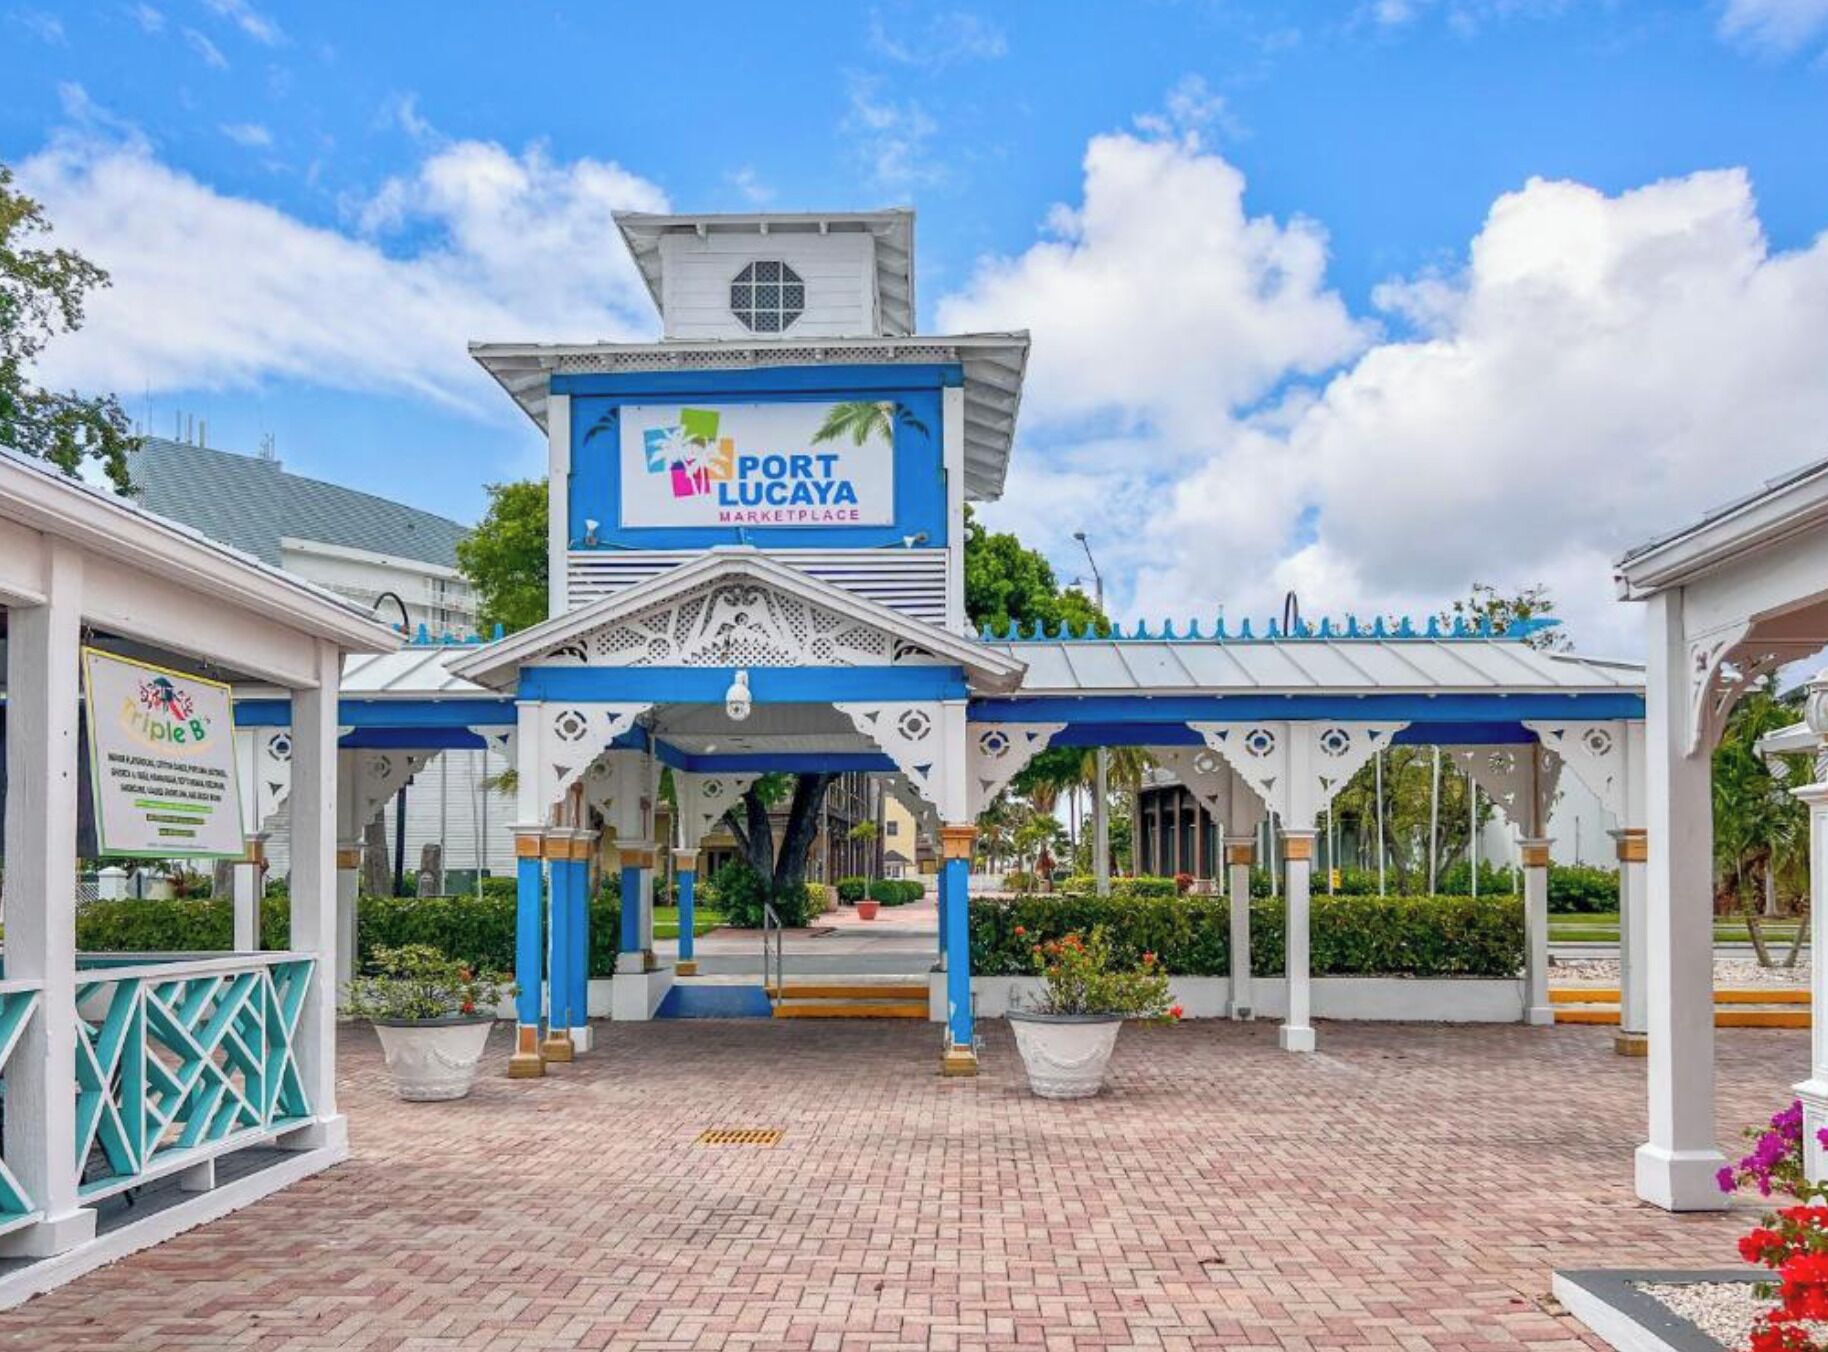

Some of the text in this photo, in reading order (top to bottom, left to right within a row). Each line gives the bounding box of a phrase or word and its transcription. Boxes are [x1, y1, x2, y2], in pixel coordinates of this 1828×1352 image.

[738, 454, 839, 479] PORT
[718, 480, 858, 506] LUCAYA
[719, 509, 860, 522] MARKETPLACE
[121, 696, 187, 743] Triple
